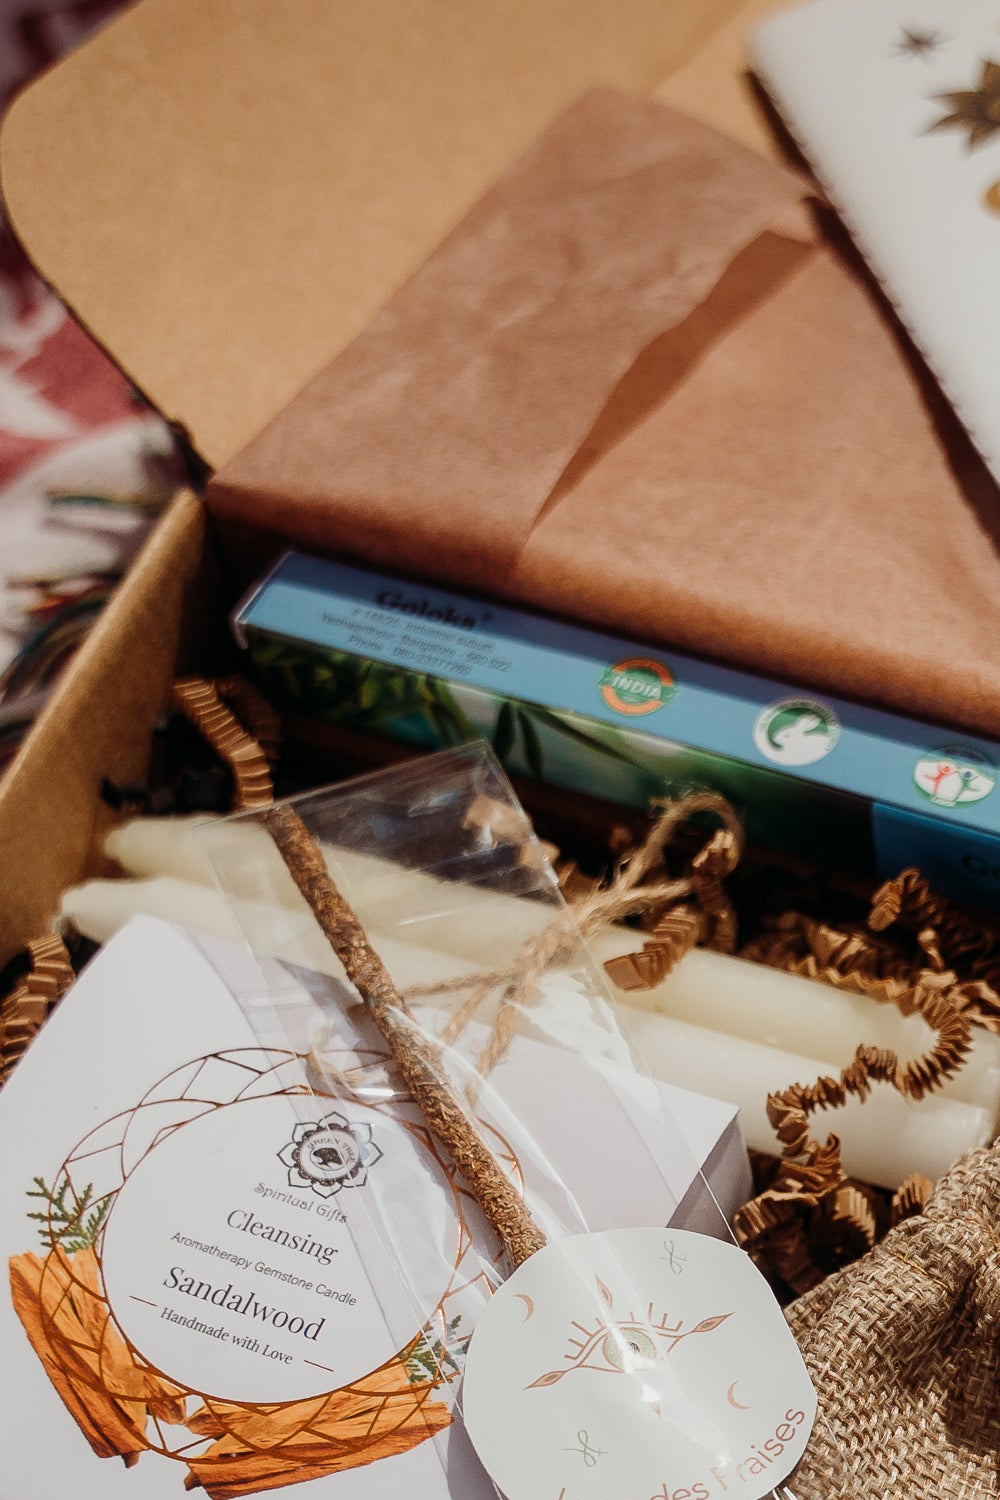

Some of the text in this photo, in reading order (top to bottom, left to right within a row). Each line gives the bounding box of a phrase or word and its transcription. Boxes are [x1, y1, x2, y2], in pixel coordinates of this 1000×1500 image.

[612, 674, 661, 698] INDIA
[342, 1142, 356, 1163] TREE
[254, 1182, 348, 1224] Spiritual Gifts
[227, 1209, 338, 1266] Cleansing
[170, 1232, 357, 1306] Aromatherapy Gemstone Candle
[163, 1266, 326, 1341] Sandalwood
[160, 1306, 293, 1365] Handmade with Love
[710, 1408, 805, 1492] Fraises
